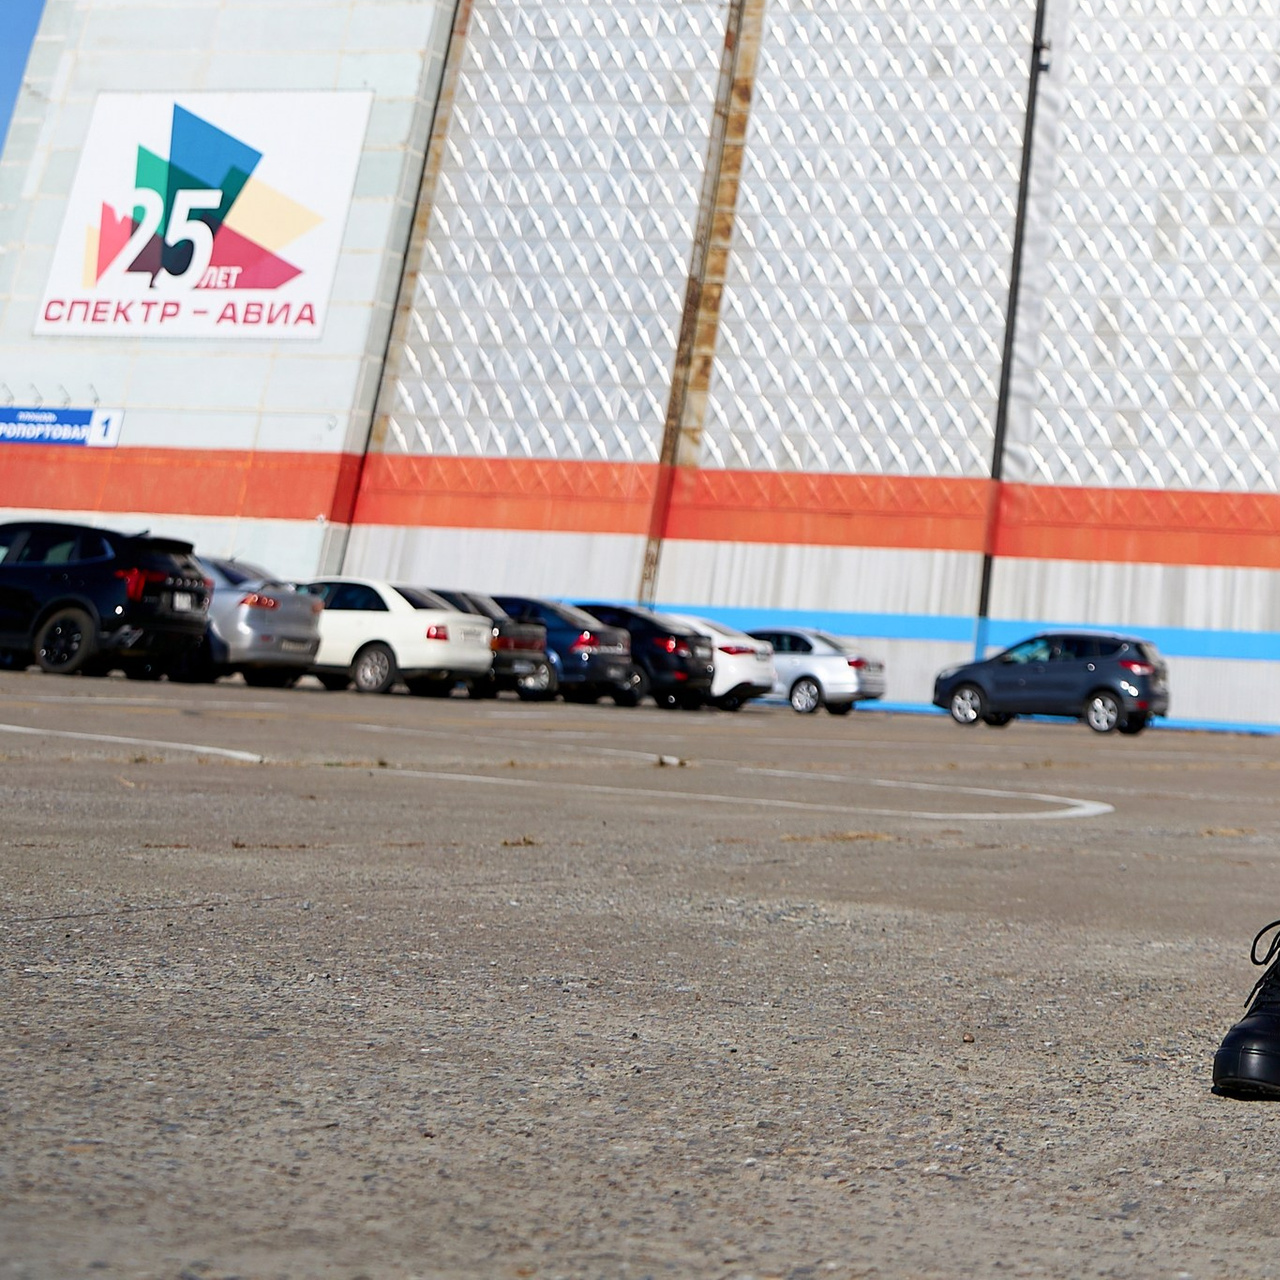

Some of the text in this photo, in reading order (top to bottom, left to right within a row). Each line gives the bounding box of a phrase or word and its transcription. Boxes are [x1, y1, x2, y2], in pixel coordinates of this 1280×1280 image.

[95, 186, 223, 291] 25
[199, 265, 243, 288] ЛЕТ
[44, 299, 181, 324] СПЕКТР
[215, 302, 317, 326] АВИА
[101, 414, 112, 438] 1
